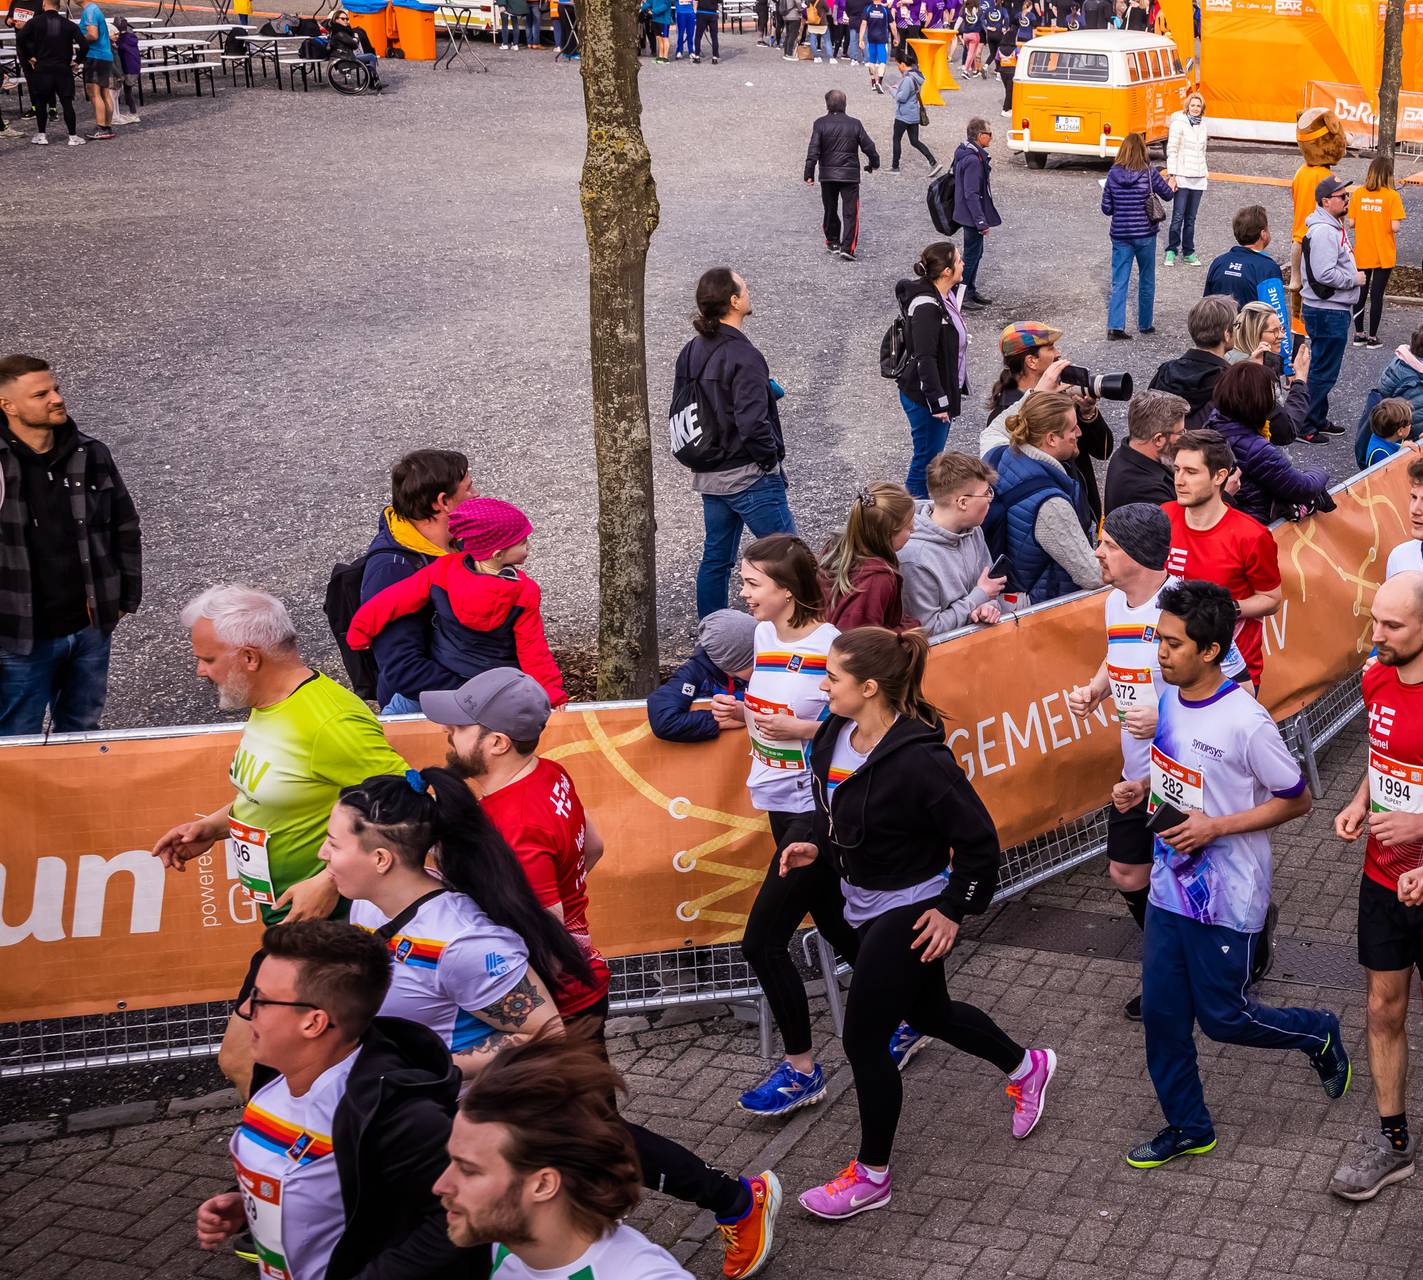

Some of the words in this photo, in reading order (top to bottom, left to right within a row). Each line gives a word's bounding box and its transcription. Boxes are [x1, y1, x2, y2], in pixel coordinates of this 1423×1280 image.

[1335, 98, 1380, 125] DzRu
[1267, 287, 1281, 311] LINE
[669, 402, 704, 454] IKE
[1114, 683, 1137, 701] 372
[945, 687, 1120, 784] GEMEIN
[1191, 738, 1225, 758] SYNOPSYS
[230, 749, 271, 793] WV
[1162, 773, 1184, 800] 282
[1378, 775, 1411, 801] 1994
[198, 845, 223, 929] powere
[488, 964, 511, 978] ALDI
